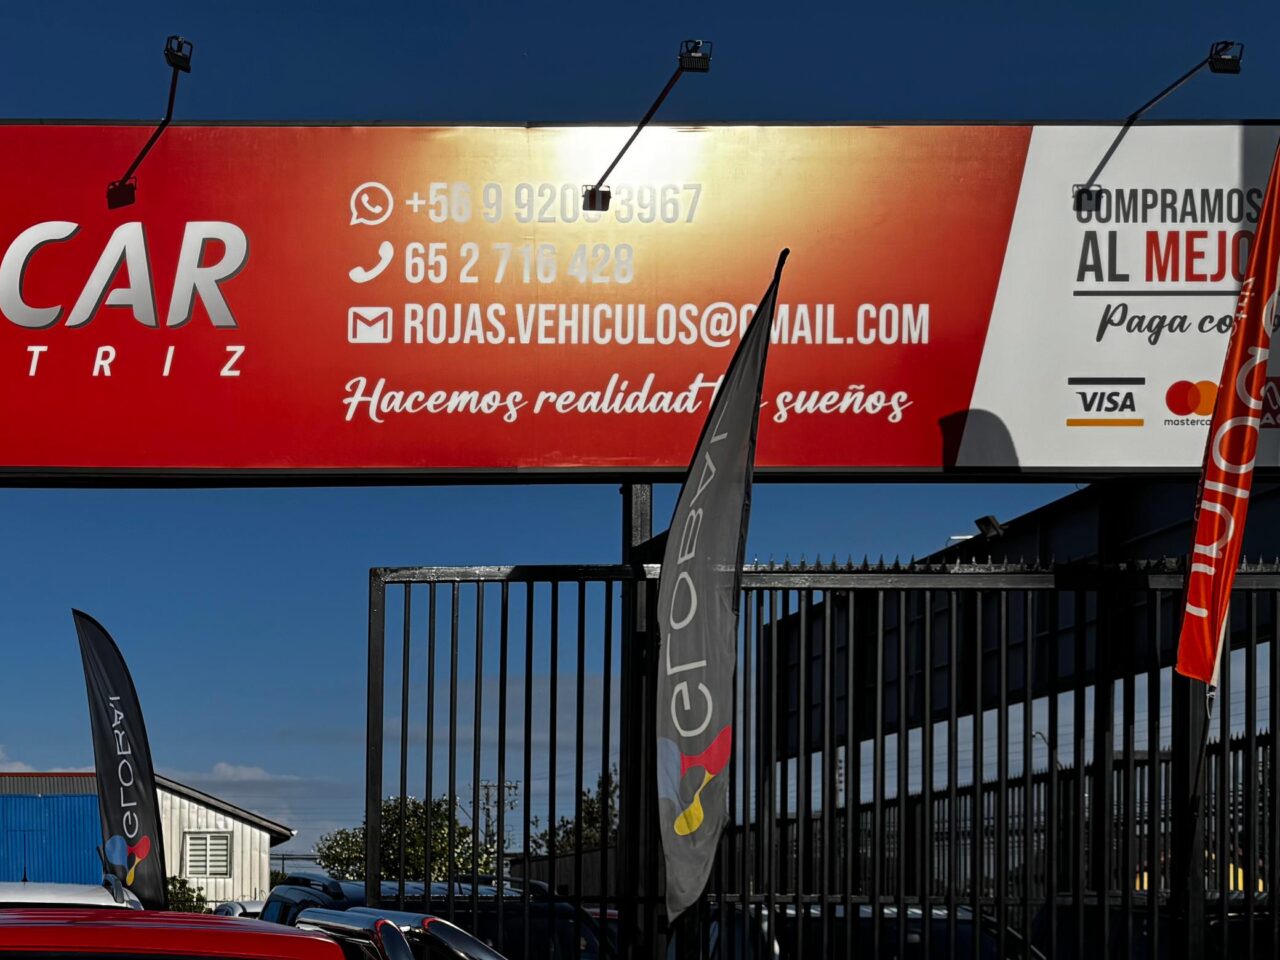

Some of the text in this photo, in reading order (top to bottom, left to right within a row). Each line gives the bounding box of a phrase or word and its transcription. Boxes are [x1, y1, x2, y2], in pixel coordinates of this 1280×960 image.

[405, 183, 472, 223] +56
[482, 183, 503, 223] 9
[614, 184, 702, 223] 3967
[1074, 188, 1263, 224] COMPRAMOS
[404, 242, 634, 284] 65 2 716 428
[1076, 230, 1257, 282] AL MEJO
[1095, 302, 1193, 346] Paga
[1197, 314, 1235, 334] co
[342, 376, 528, 423] Hacemos
[533, 372, 704, 415] realidad
[773, 384, 915, 424] sueños
[1075, 391, 1136, 412] VISA
[1163, 418, 1212, 427] masterca
